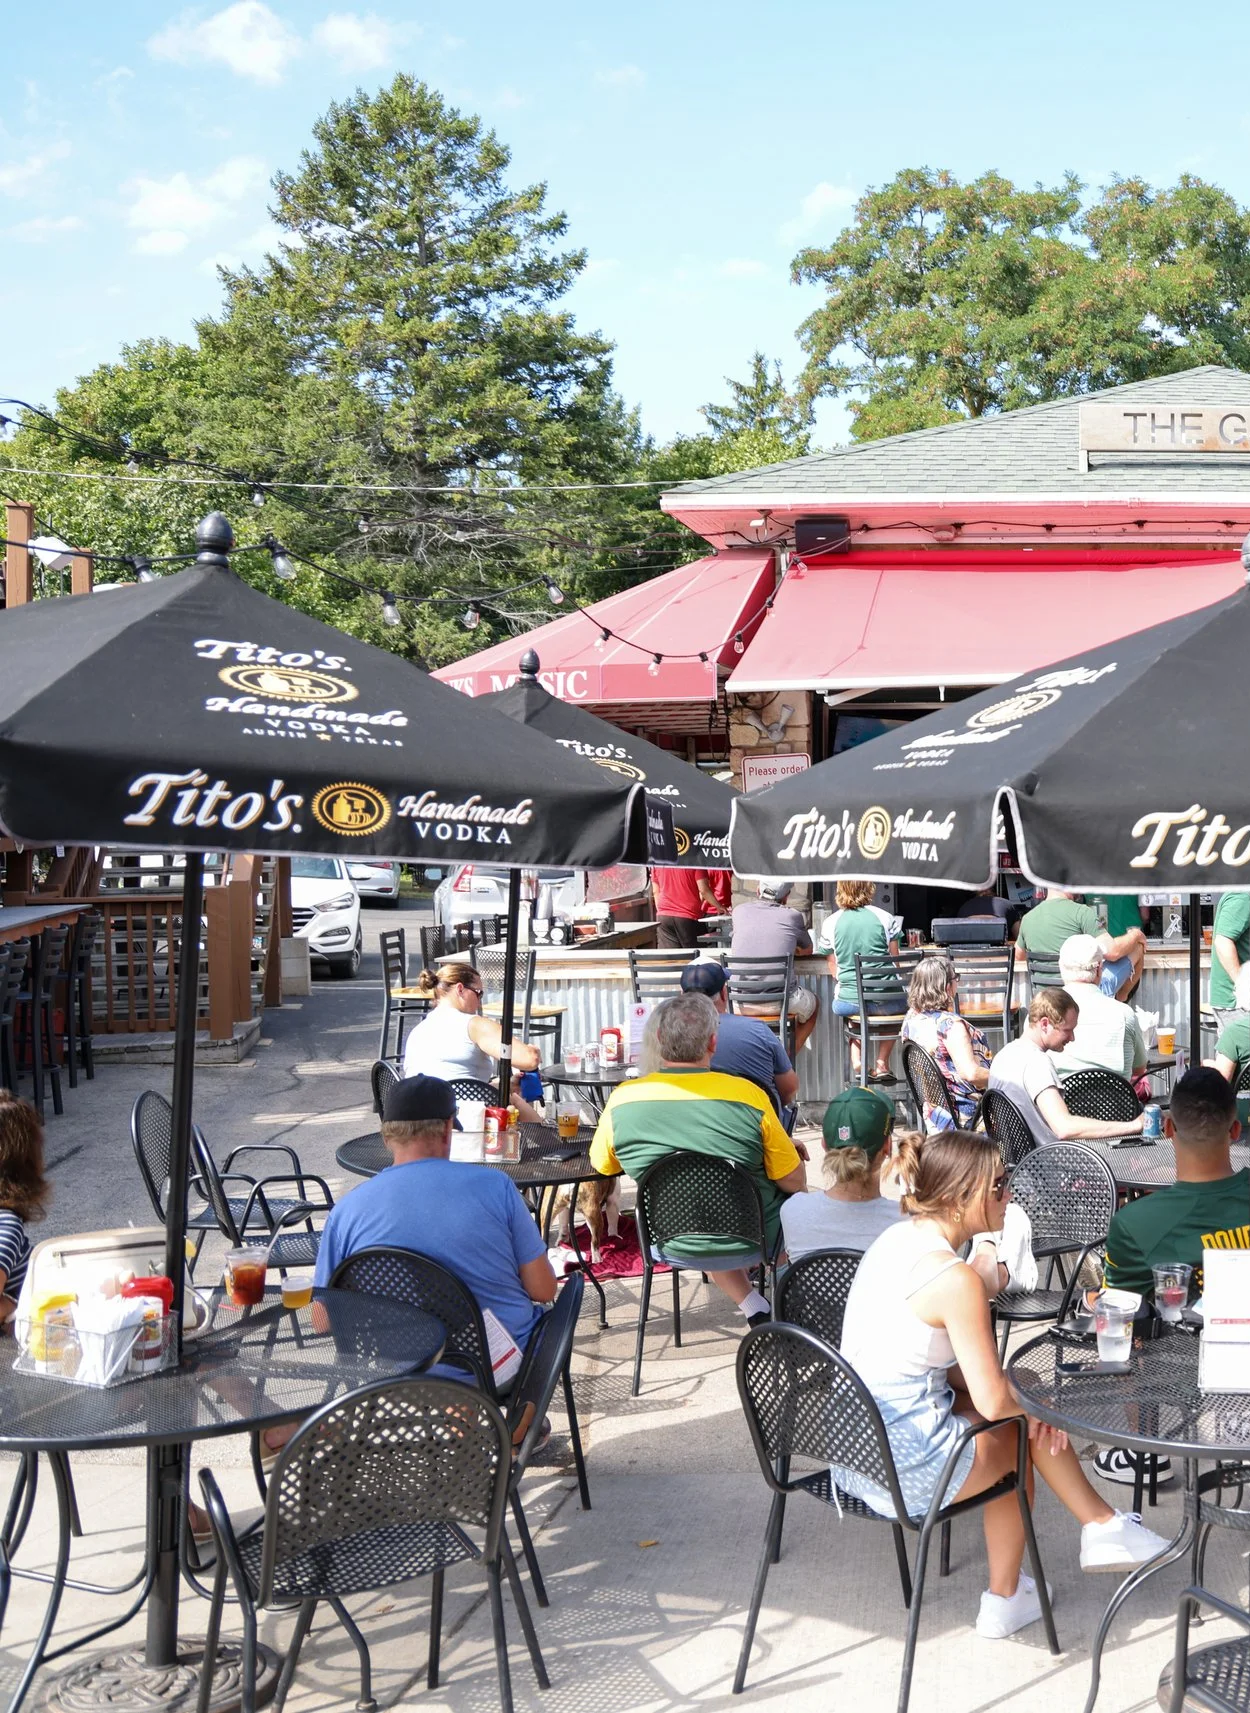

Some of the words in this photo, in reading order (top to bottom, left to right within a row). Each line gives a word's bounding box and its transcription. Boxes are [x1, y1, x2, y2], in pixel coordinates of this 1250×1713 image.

[1123, 412, 1203, 446] THE
[490, 670, 588, 699] MSIC
[205, 697, 408, 727] Handmade
[241, 727, 307, 739] AUSTIN
[342, 734, 403, 747] TEXAS
[264, 718, 371, 736] VODKA
[749, 766, 777, 776] Please
[781, 765, 804, 775] order
[397, 791, 532, 825] Handmade
[415, 822, 513, 846] VODKA
[702, 847, 731, 858] VOD
[901, 841, 939, 862] VODKA
